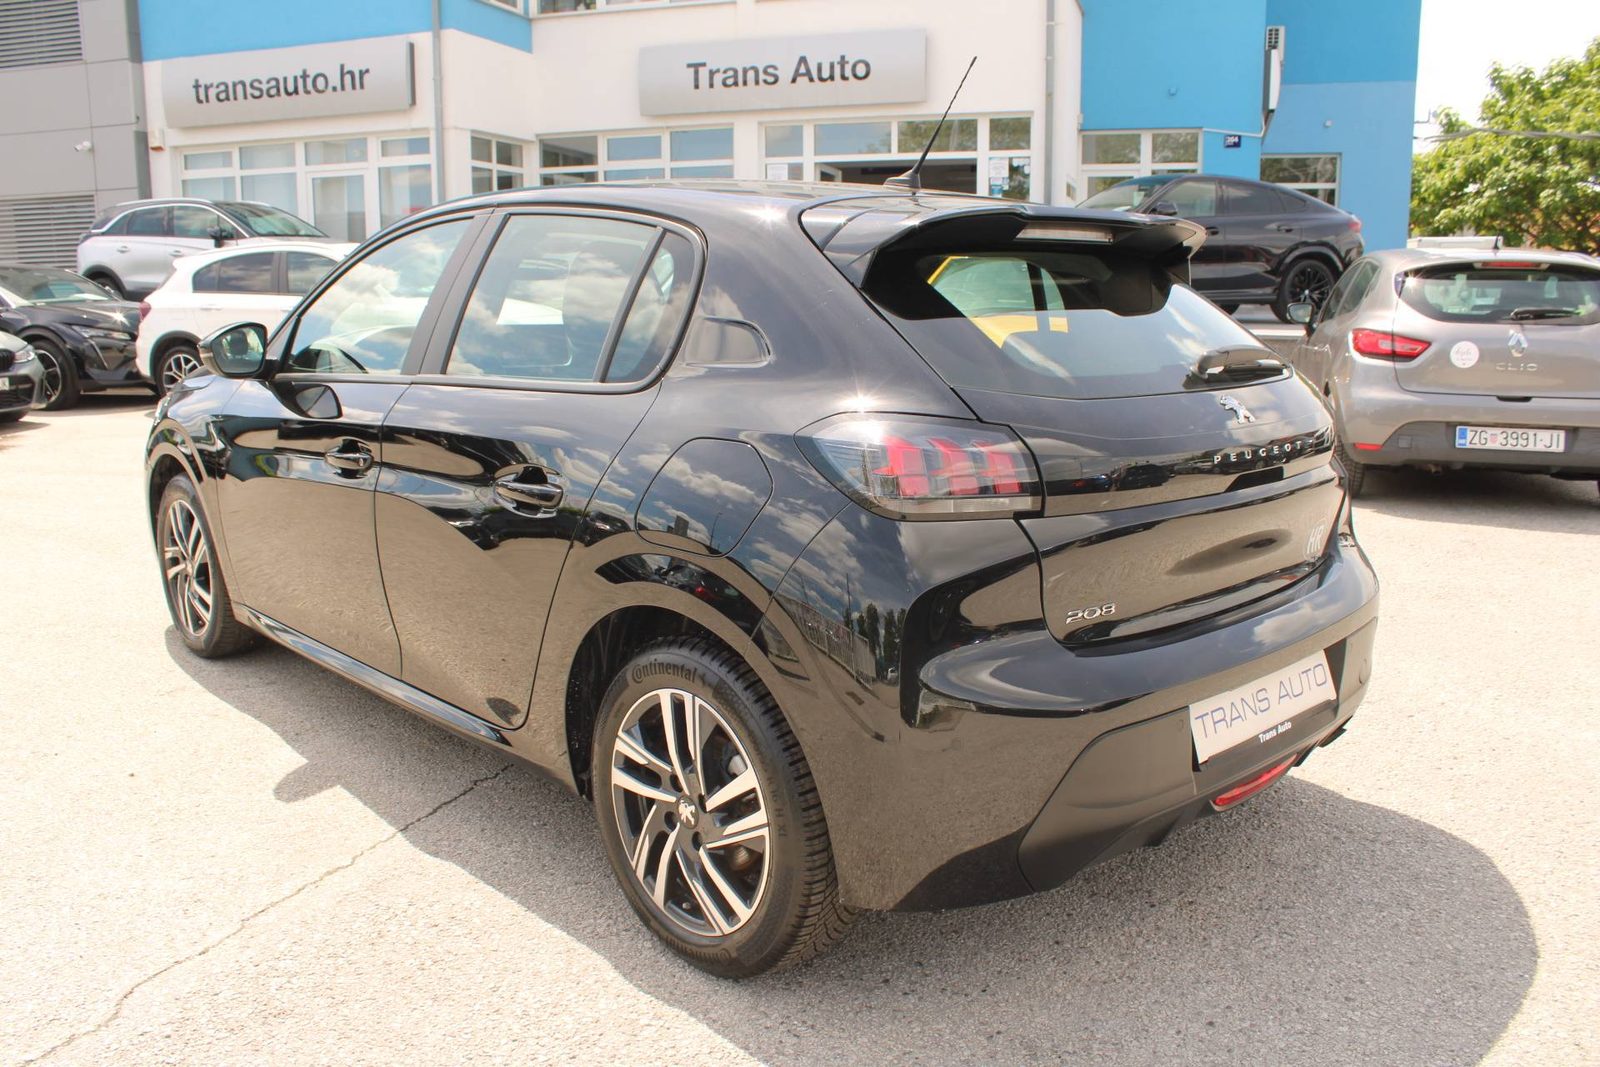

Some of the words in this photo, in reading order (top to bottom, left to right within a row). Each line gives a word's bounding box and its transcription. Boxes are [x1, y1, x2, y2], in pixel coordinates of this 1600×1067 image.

[192, 63, 370, 104] transauto.hr
[686, 61, 780, 90] Trans
[790, 53, 872, 84] Auto
[1496, 362, 1538, 372] CLIO
[1469, 430, 1488, 446] ZG
[1213, 440, 1302, 464] PEUGEOT
[1065, 602, 1116, 625] 208
[631, 657, 698, 684] Continental
[1194, 687, 1271, 739] TRANS
[1277, 662, 1329, 704] AUTO
[1258, 728, 1277, 743] Trans
[1278, 721, 1292, 734] Auto
